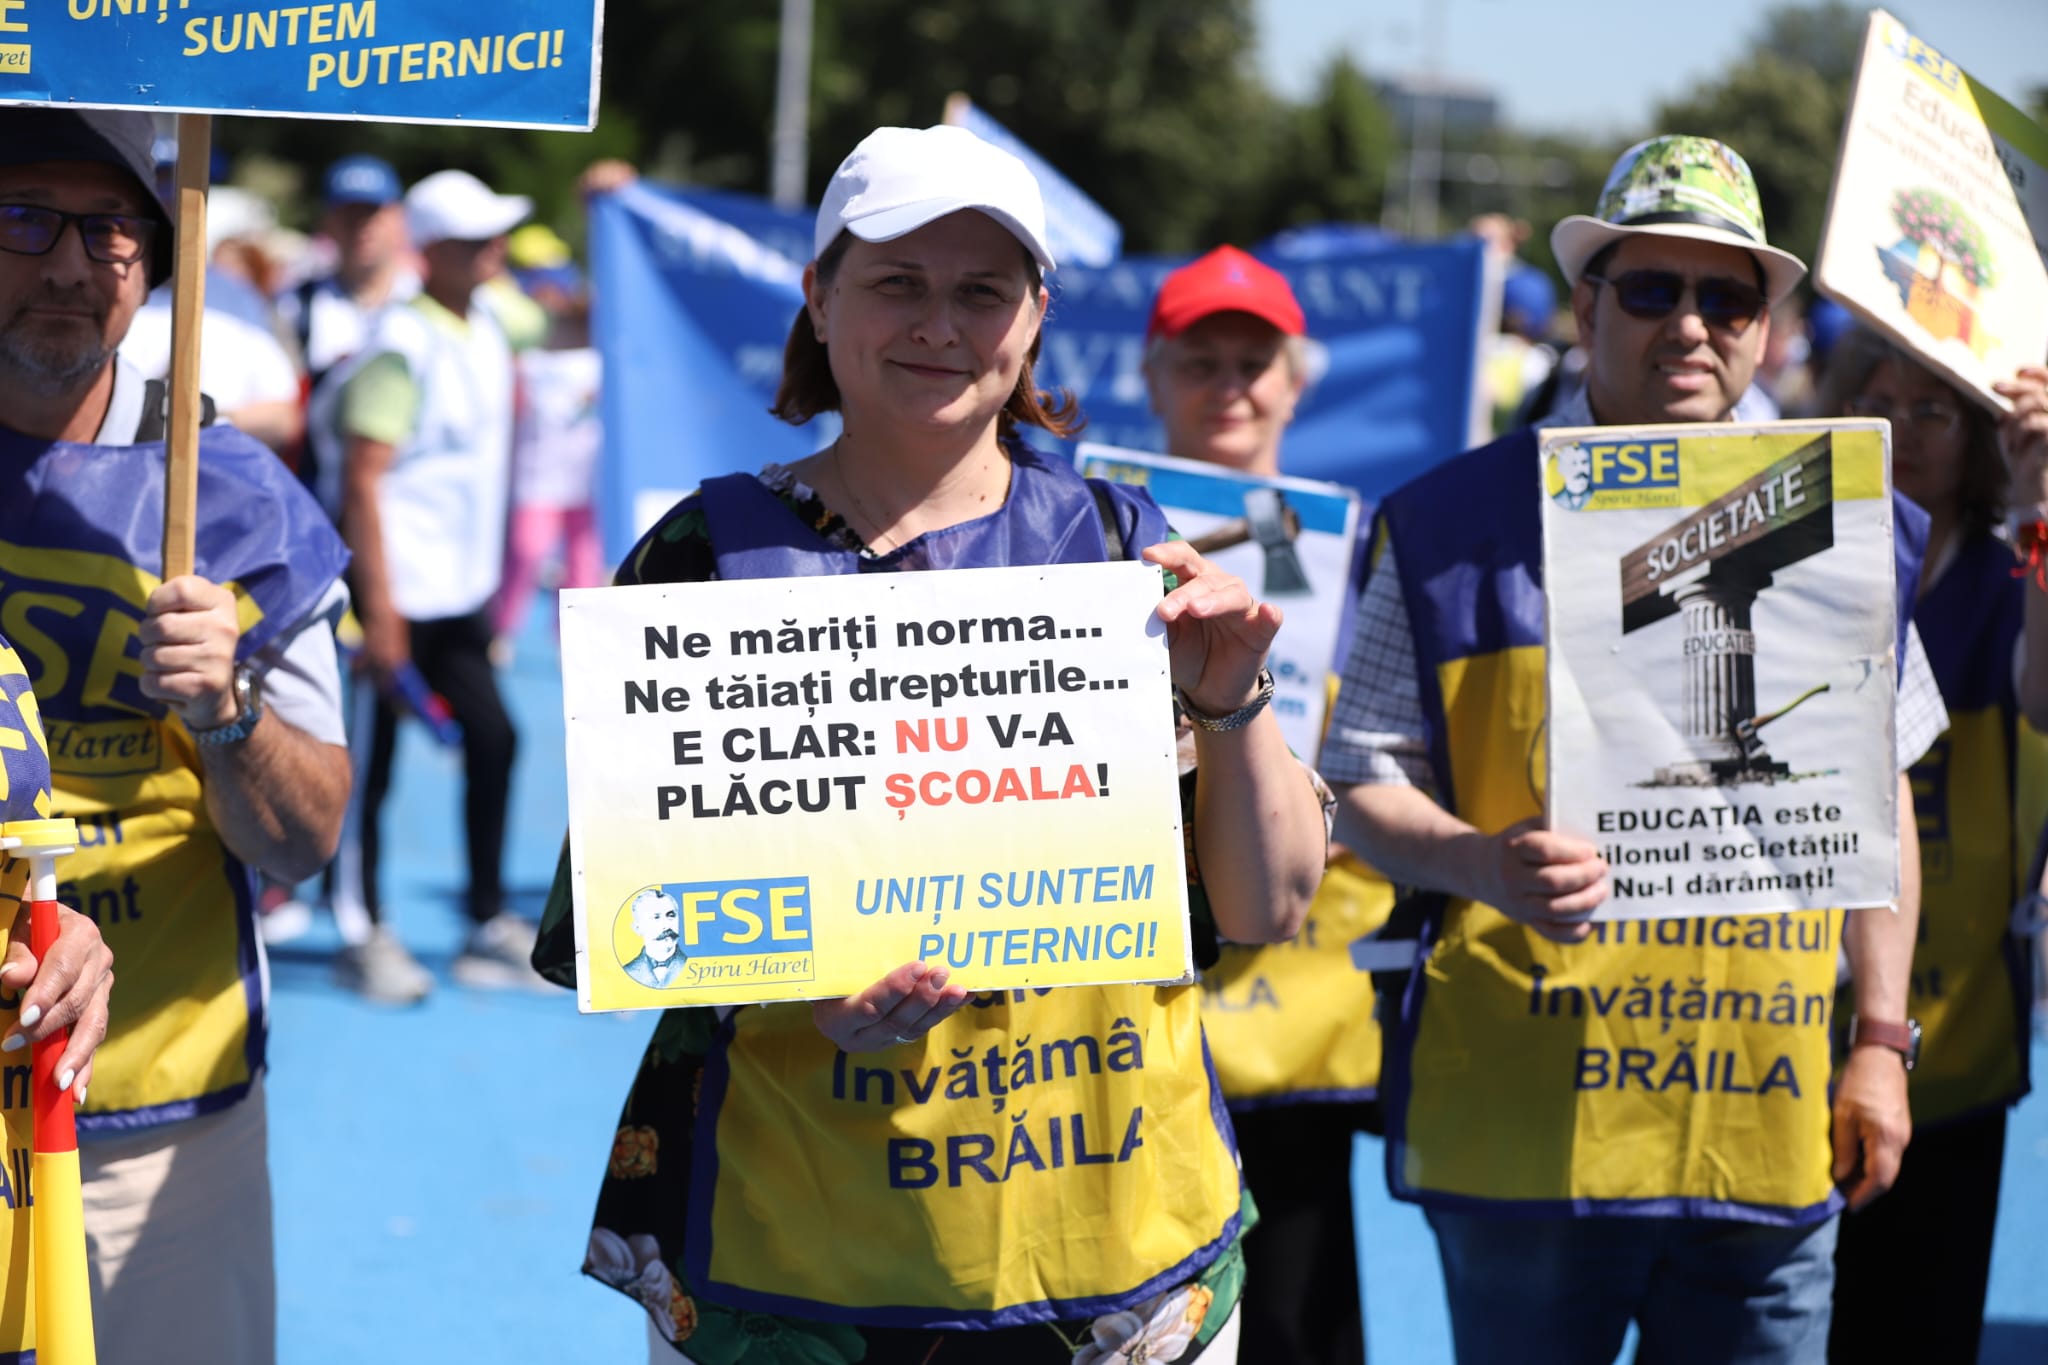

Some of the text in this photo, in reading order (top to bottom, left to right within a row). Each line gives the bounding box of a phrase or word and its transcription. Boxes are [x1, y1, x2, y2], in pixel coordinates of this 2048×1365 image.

[183, 1, 376, 57] SUNTEM
[0, 50, 27, 66] ret
[306, 30, 564, 92] PUTERNICI!
[1590, 443, 1678, 485] FSE
[1646, 462, 1805, 581] SOCIETATE
[0, 586, 160, 718] SE
[644, 615, 1102, 662] Ne măriți norma...
[624, 659, 1129, 718] Ne tăiați drepturile...
[673, 711, 1075, 765] E CLAR: NU V-A
[657, 762, 1110, 821] PLĂCUT ȘCOALA!
[1597, 801, 1841, 835] EDUCAȚIA este
[1597, 833, 1859, 866] ilonul societății!
[856, 864, 1154, 926] UNIȚI SUNTEM
[1613, 867, 1834, 899] Nu-l dărâmați!
[682, 886, 809, 946] FSE
[1583, 909, 1829, 952] indicatul
[686, 956, 809, 986] Spiru Haret
[918, 921, 1158, 969] PUTERNICI!
[1529, 964, 1830, 1035] Învățămân
[1574, 1040, 1802, 1099] BRĂILA
